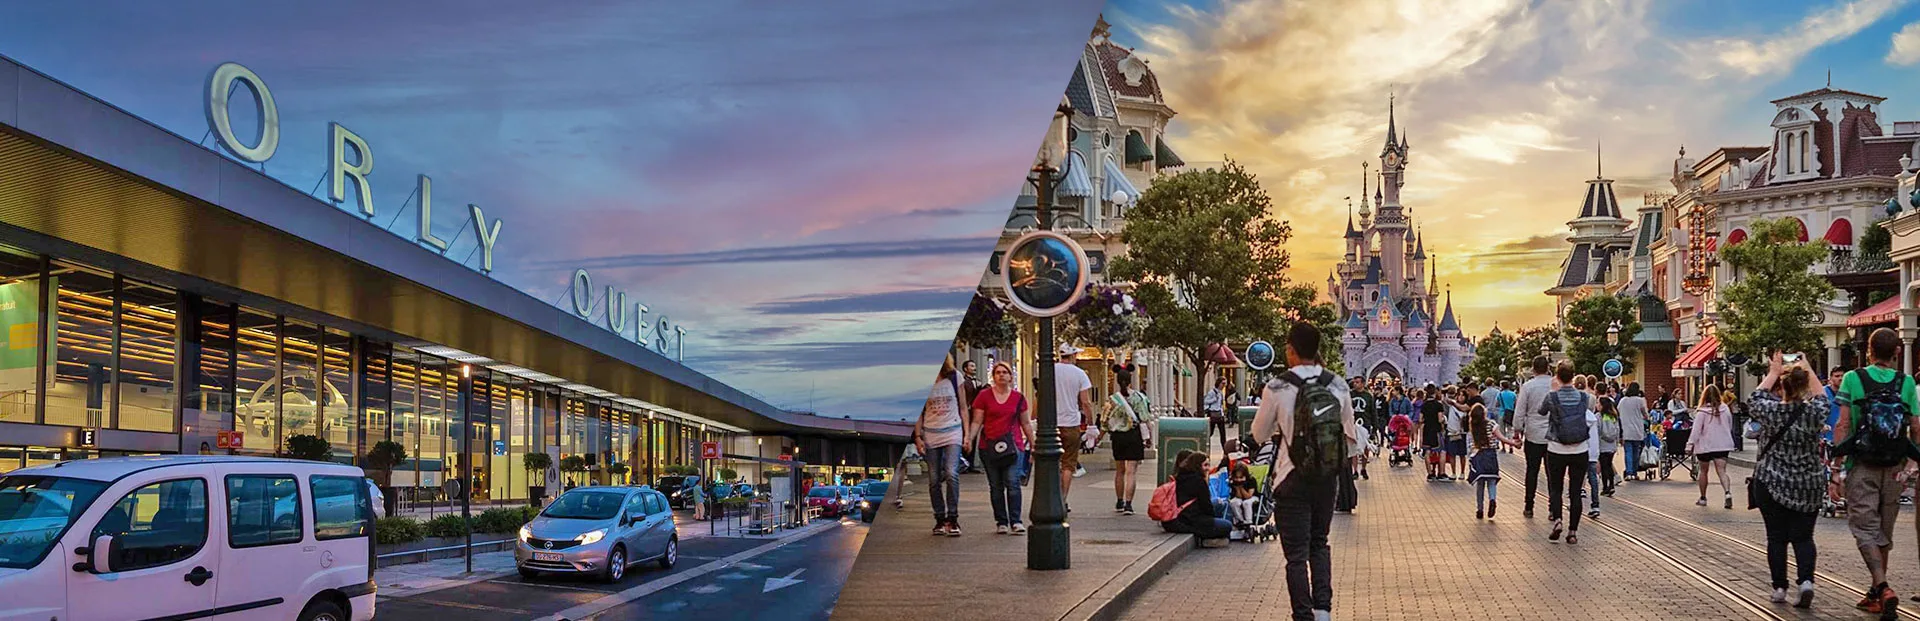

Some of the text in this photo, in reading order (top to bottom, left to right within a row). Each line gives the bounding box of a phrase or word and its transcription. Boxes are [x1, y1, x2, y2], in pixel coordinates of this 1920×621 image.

[204, 62, 687, 361] ORLY OUEST
[85, 431, 92, 444] E
